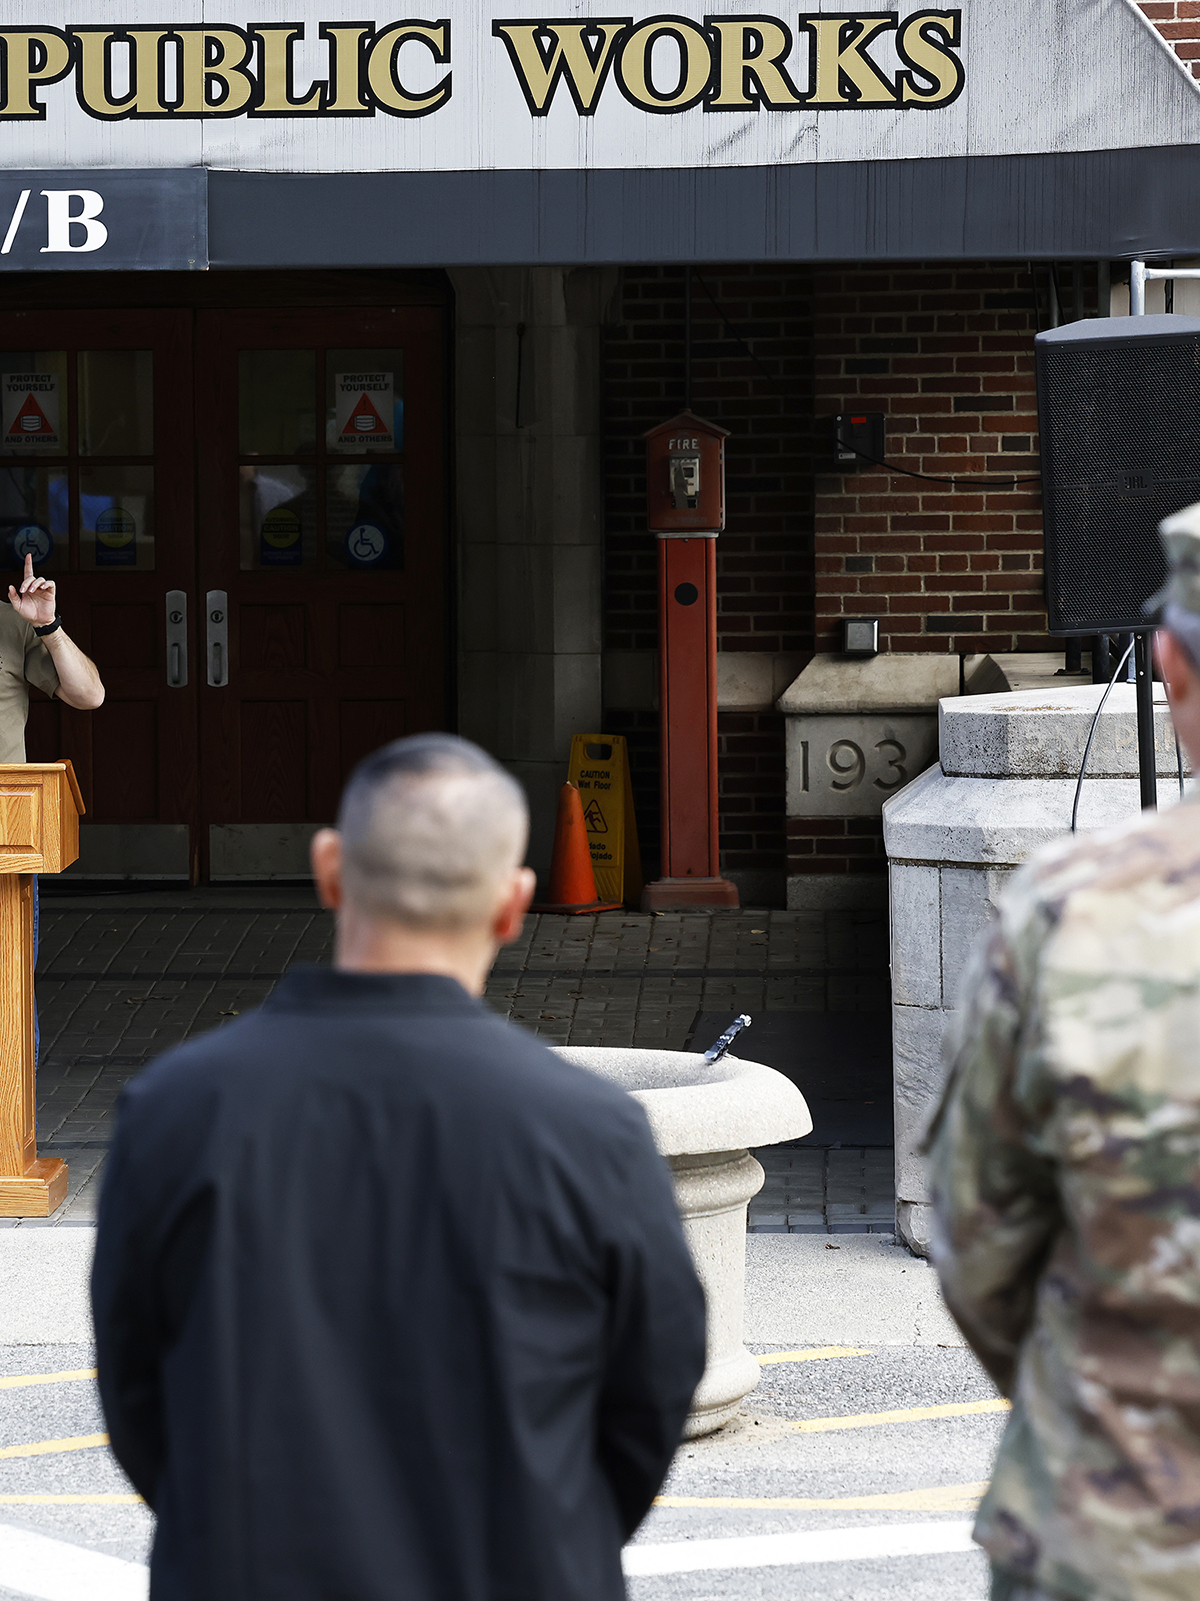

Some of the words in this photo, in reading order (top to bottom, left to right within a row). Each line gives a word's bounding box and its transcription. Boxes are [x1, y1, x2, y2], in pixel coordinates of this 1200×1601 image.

[492, 9, 965, 117] WORKS
[10, 374, 52, 383] PROTECT
[343, 374, 386, 383] PROTECT
[6, 383, 56, 392] YOURSELF
[340, 383, 390, 391] YOURSELF
[4, 435, 23, 443] AND
[25, 435, 58, 443] OTHERS
[338, 435, 356, 443] AND
[668, 438, 699, 450] FIRE
[263, 524, 299, 532] CAUTION
[800, 738, 908, 793] 193
[580, 770, 610, 779] CAUTION
[578, 780, 590, 788] Wet
[594, 780, 611, 790] Floor
[590, 851, 612, 861] ojado
